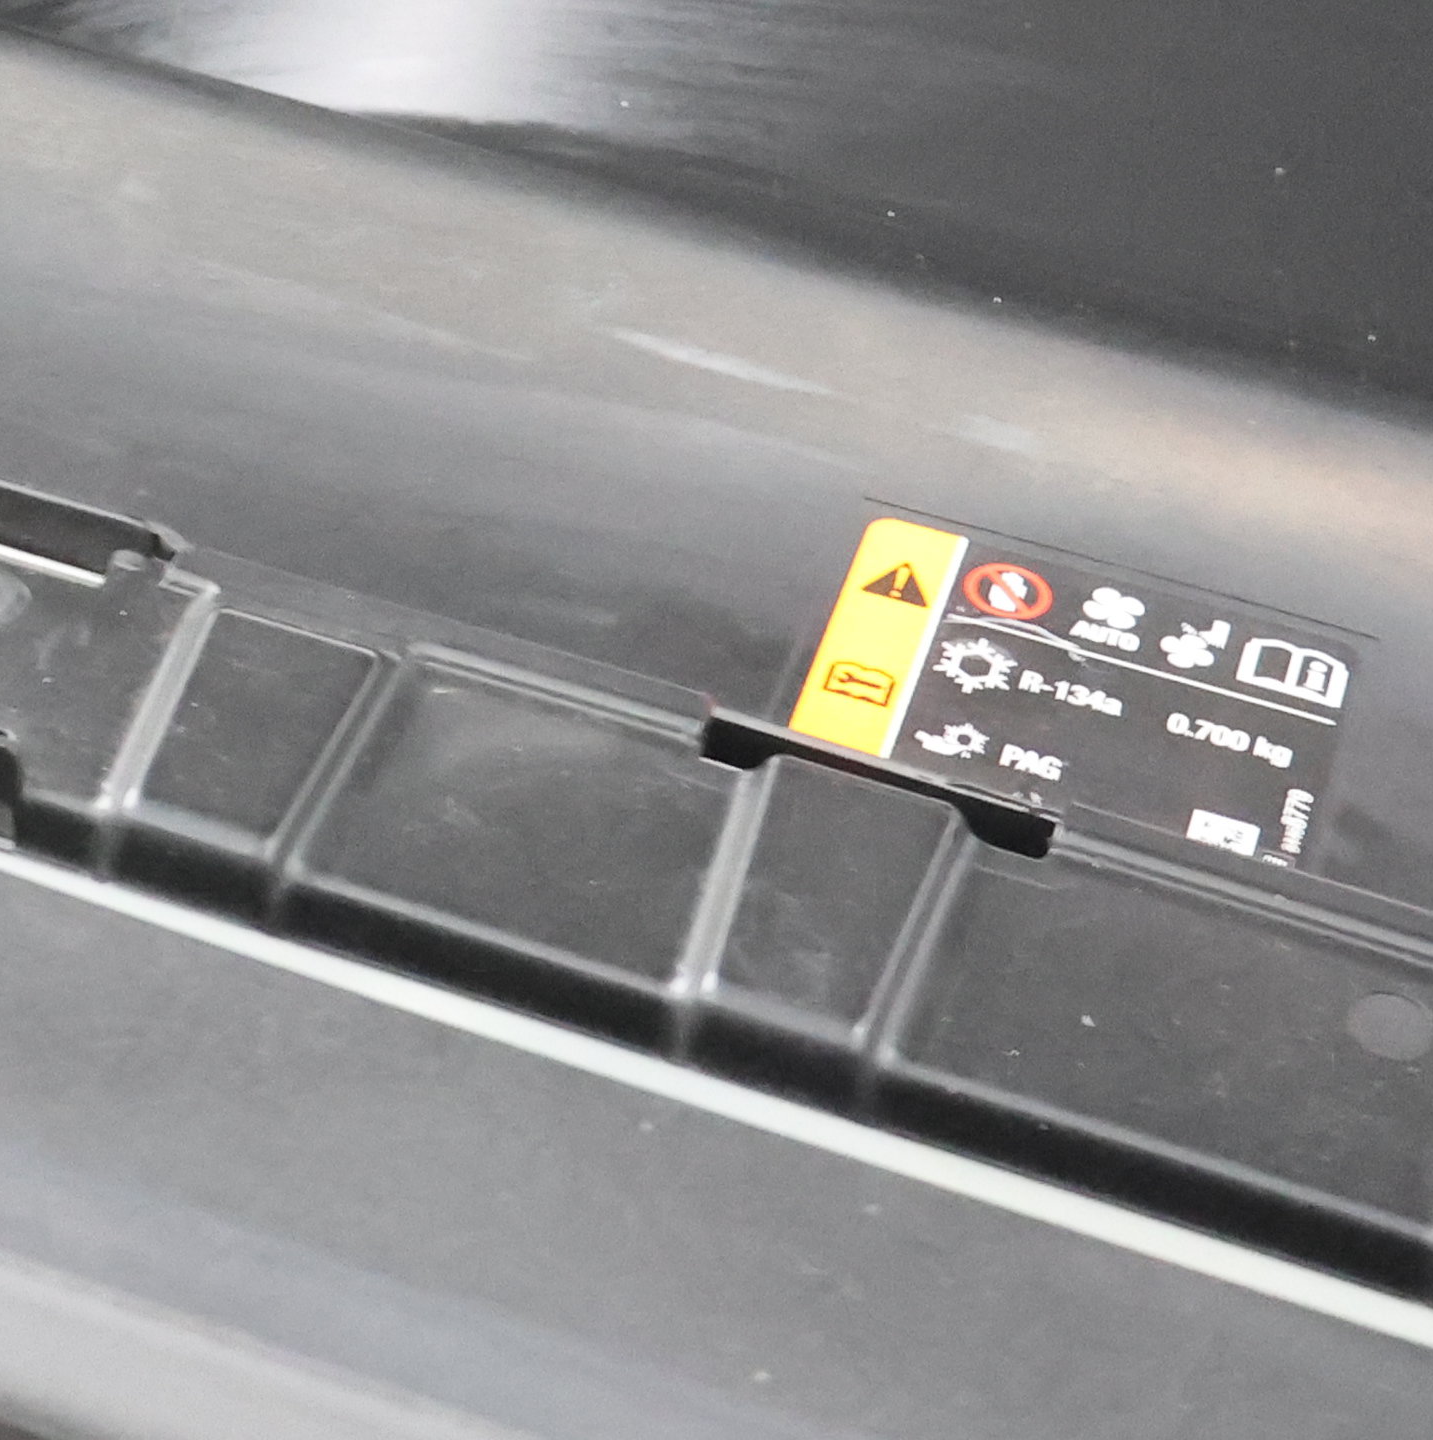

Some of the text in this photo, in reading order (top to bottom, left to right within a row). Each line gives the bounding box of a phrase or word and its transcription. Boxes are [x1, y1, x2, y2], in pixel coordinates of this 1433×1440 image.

[1069, 620, 1141, 652] AUTO
[1018, 670, 1123, 717] R-134a
[998, 743, 1063, 781] PAG
[1166, 712, 1294, 770] 0.700 kg
